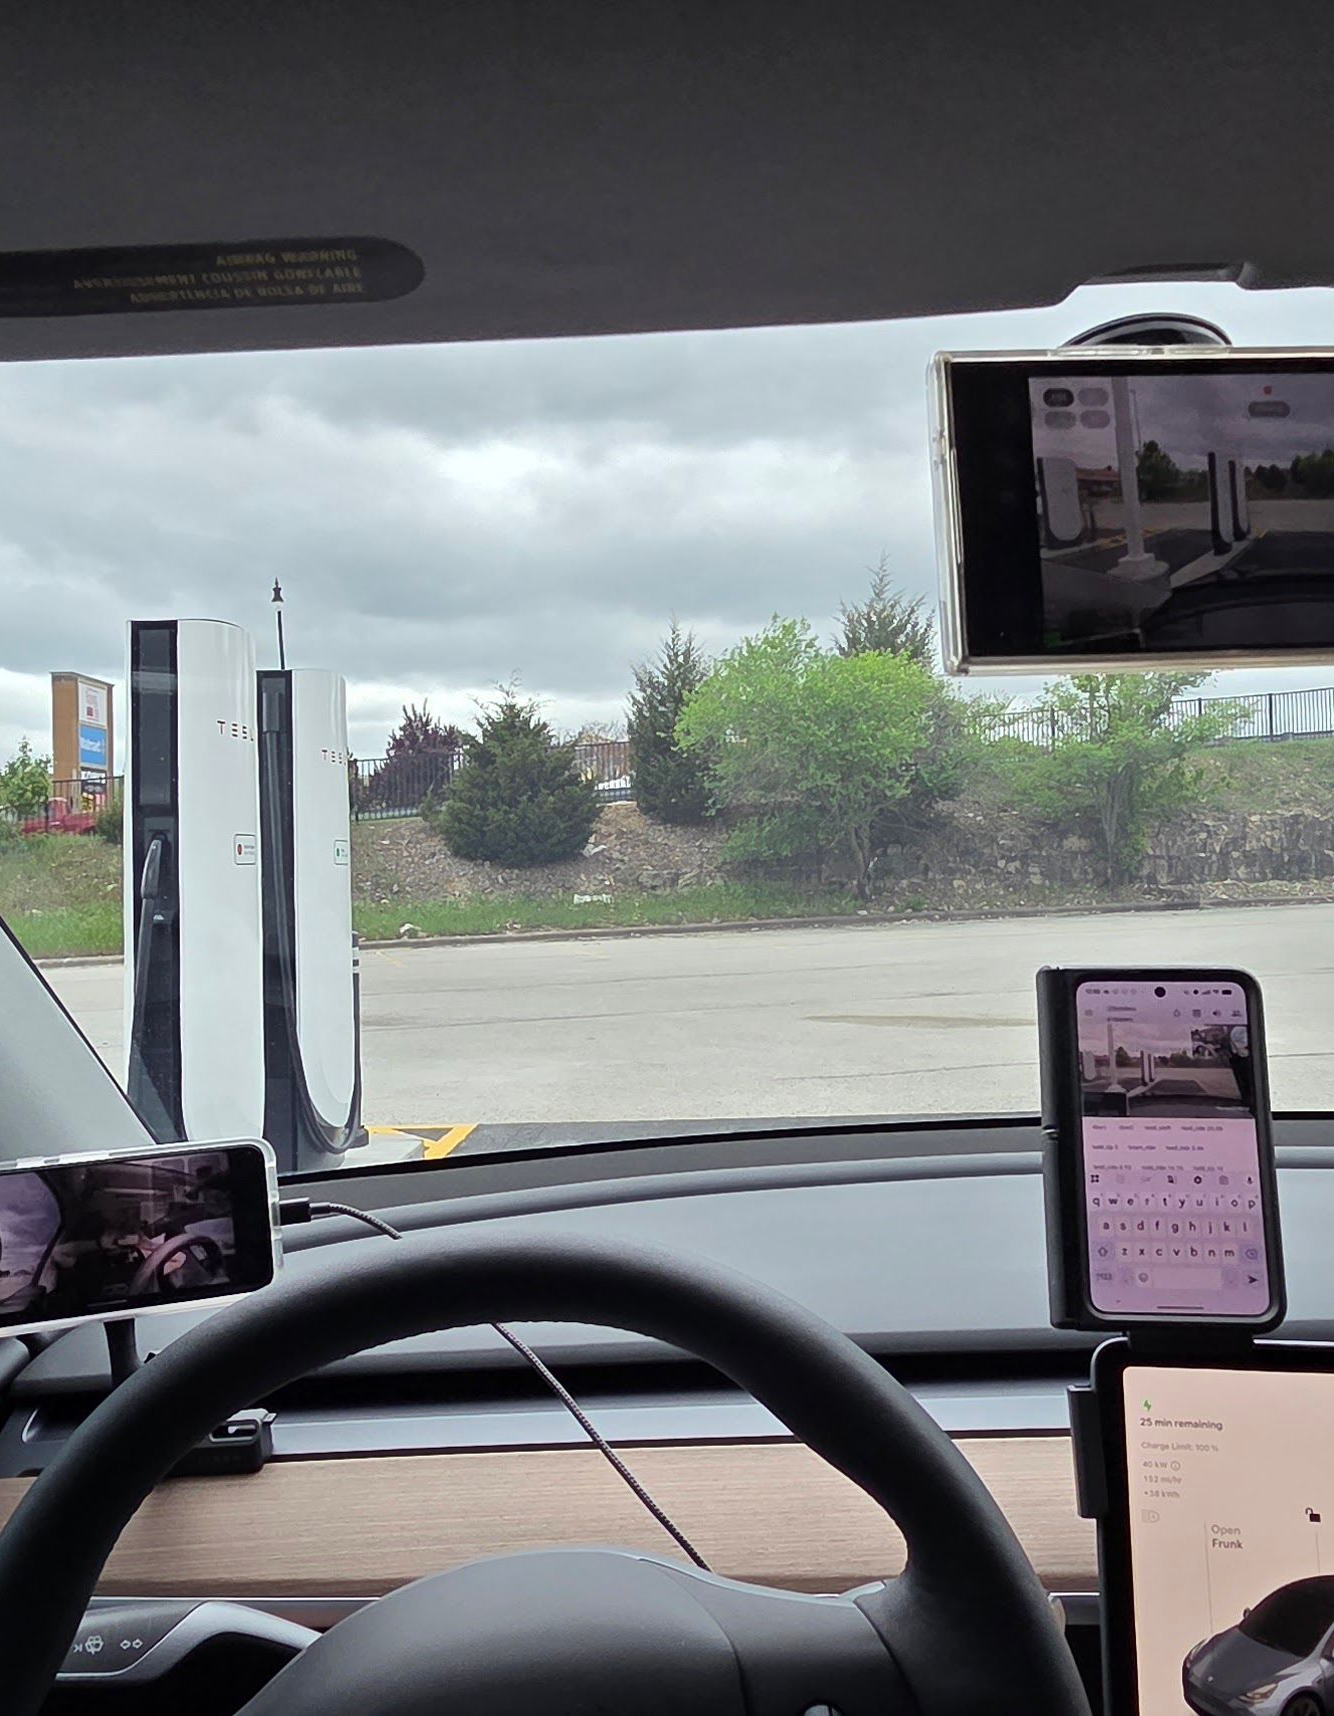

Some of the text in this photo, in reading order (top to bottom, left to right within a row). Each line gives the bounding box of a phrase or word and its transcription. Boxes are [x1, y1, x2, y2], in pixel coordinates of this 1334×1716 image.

[1140, 1417, 1223, 1431] 25 min remaining
[1211, 1524, 1241, 1536] Open
[1212, 1539, 1243, 1549] Frunk
